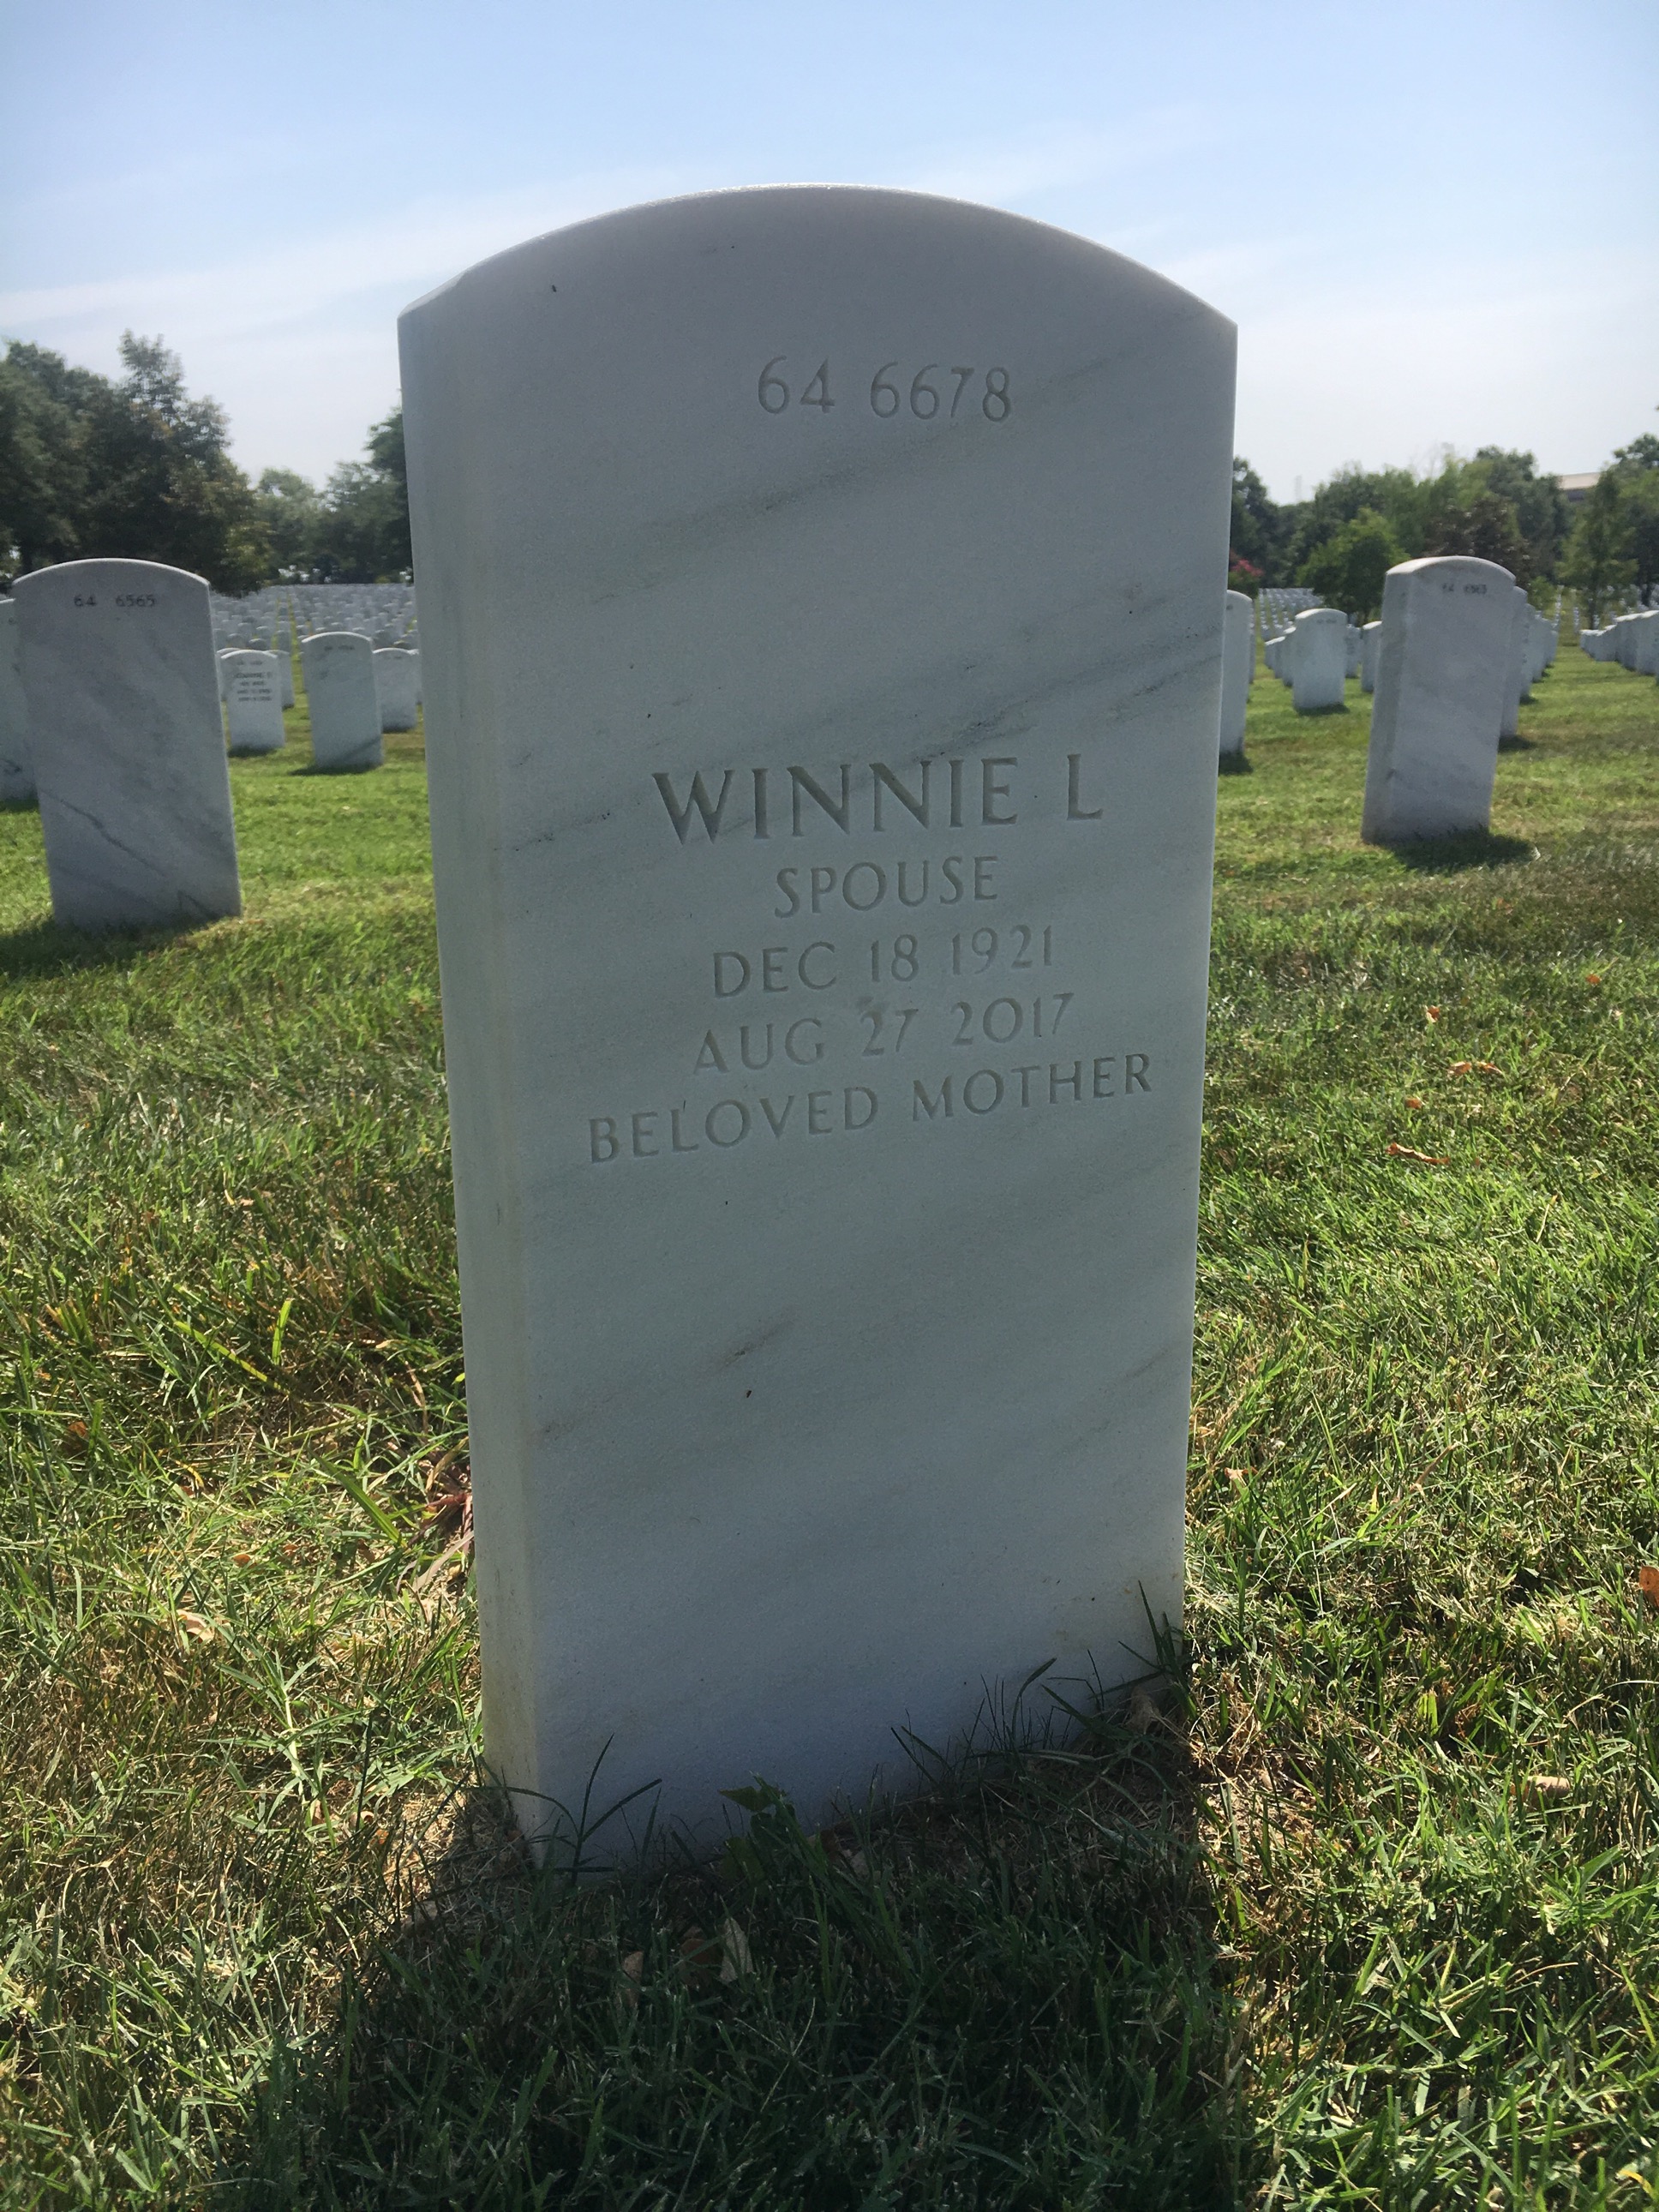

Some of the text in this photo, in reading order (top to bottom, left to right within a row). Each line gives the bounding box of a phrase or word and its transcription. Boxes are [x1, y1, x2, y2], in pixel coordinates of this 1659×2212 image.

[758, 355, 1011, 422] 64 6678
[74, 593, 155, 607] 64 6565
[652, 753, 1104, 845] WINNIE L
[774, 856, 998, 919] SPOUSE
[712, 925, 1052, 998] DEC 18 1921
[692, 992, 1075, 1075] AUG 27 2017
[588, 1052, 1153, 1164] BELOVED MOTHER
